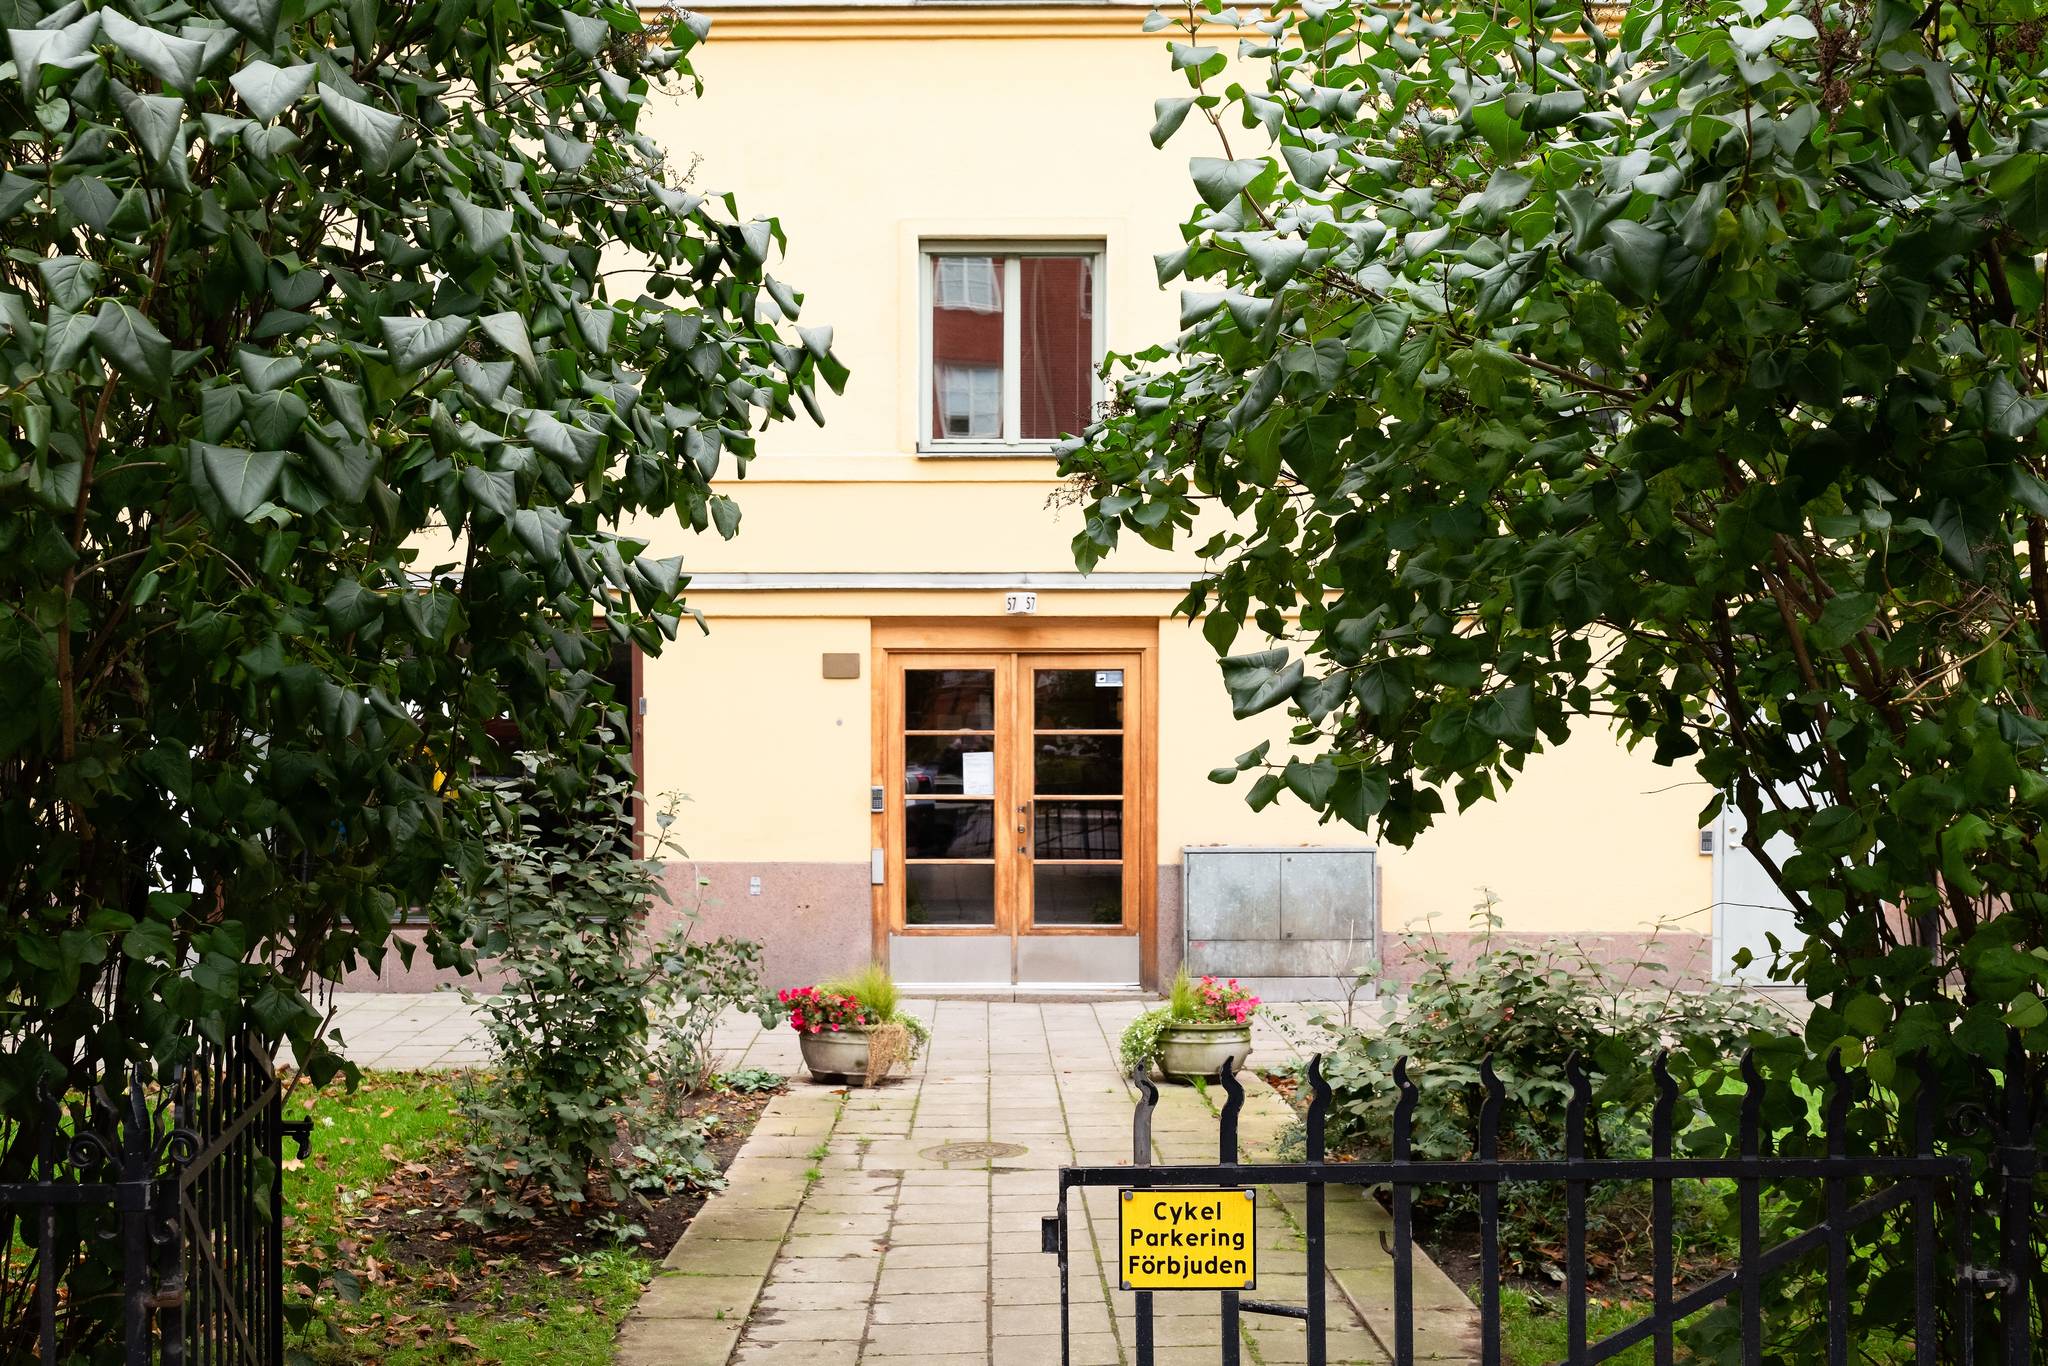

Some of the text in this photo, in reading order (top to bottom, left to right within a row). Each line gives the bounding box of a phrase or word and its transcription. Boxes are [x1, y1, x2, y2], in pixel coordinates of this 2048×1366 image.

[1007, 597, 1017, 611] 57
[1026, 596, 1036, 610] 57
[1153, 1201, 1221, 1225] Cykel
[1130, 1228, 1245, 1250] Parkering
[1129, 1255, 1247, 1279] Förbjuden
